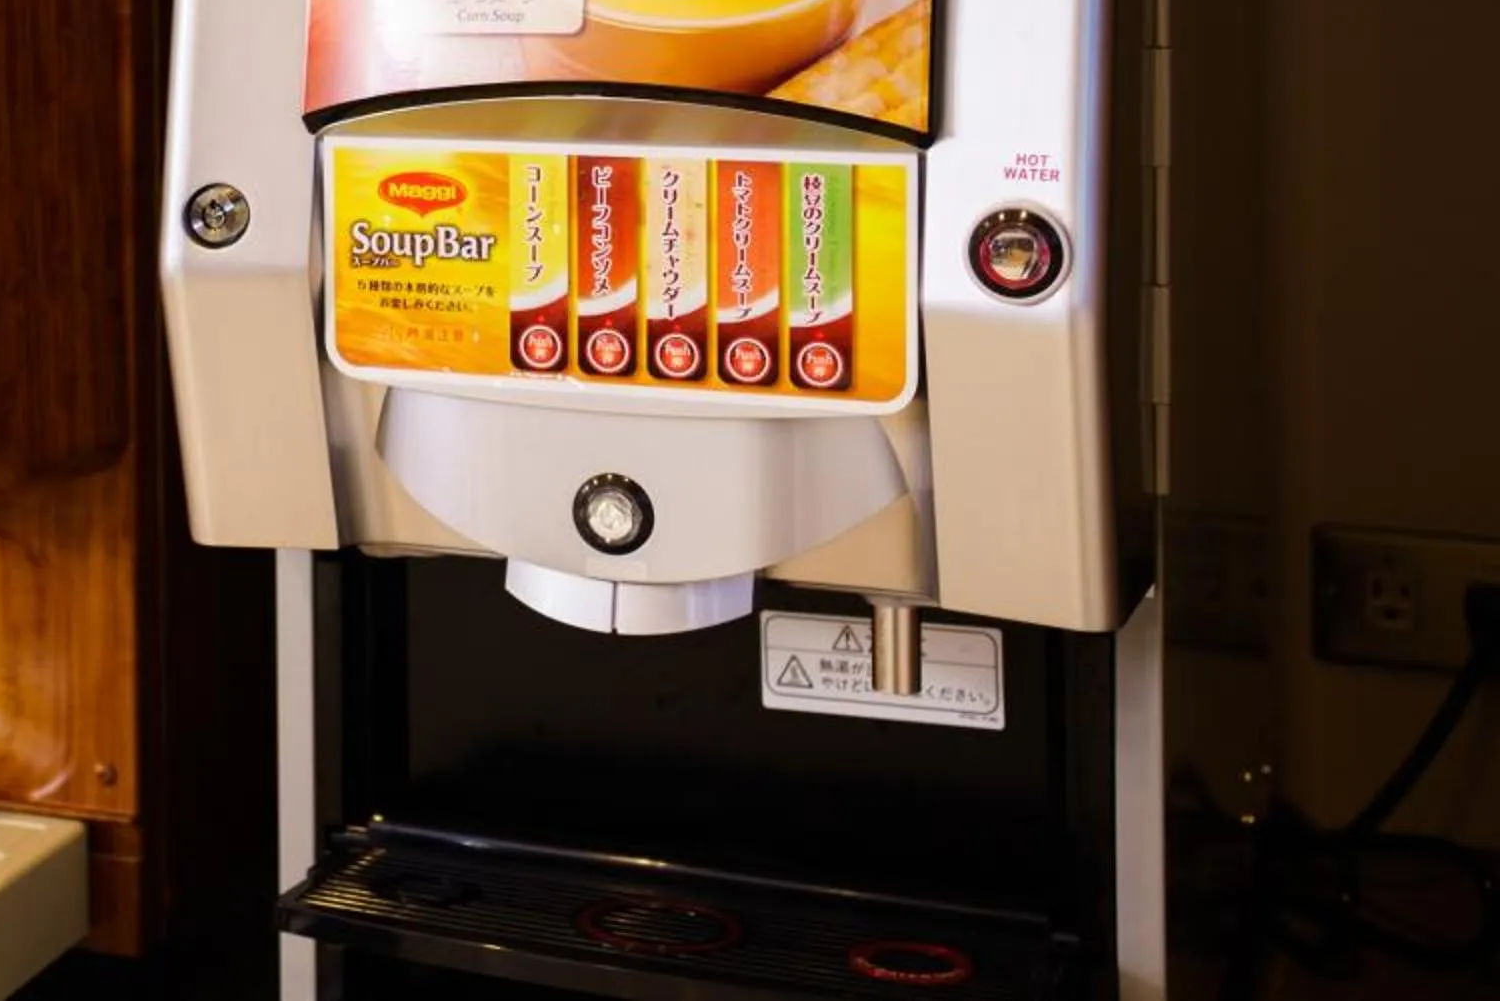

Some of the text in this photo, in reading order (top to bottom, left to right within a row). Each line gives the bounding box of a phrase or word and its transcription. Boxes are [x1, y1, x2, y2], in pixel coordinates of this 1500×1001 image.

[491, 9, 525, 24] Soup
[388, 182, 457, 201] Maggi
[1004, 167, 1060, 182] WATER
[1015, 153, 1051, 166] HOT
[526, 166, 543, 282] コーンスープ
[594, 167, 612, 296] ビーフコンソメ
[662, 170, 681, 318] クリームチャウダー
[734, 172, 752, 320] トマトクリームスープ
[803, 175, 823, 325] 枝豆のクリームスープ
